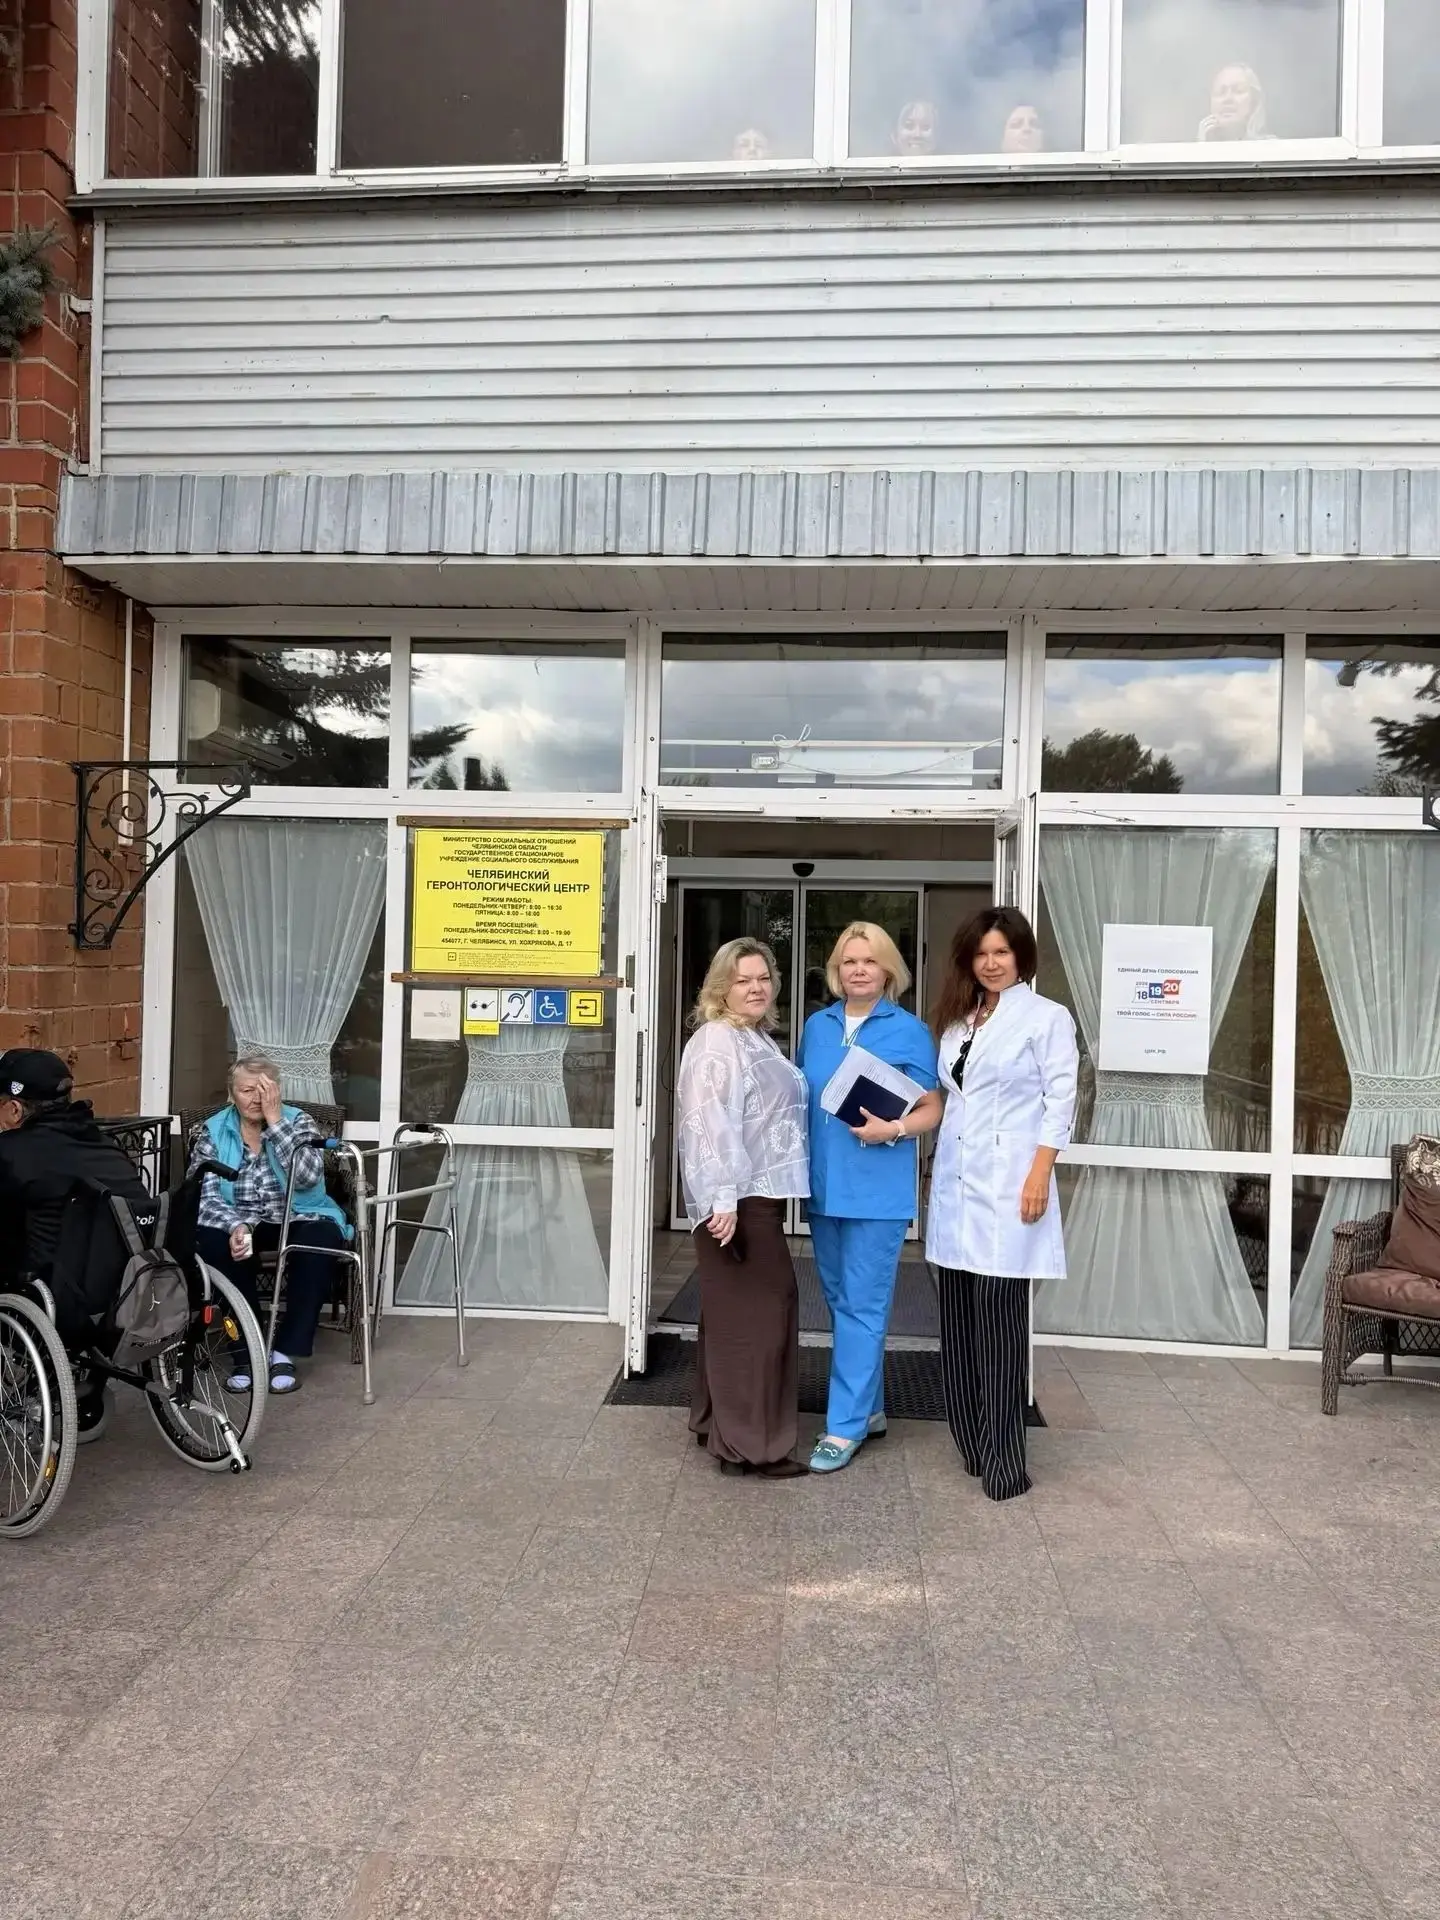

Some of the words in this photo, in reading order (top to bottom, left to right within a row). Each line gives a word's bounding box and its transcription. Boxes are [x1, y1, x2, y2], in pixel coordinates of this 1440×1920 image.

[467, 869, 550, 880] ЧЕЛЯБИНСКИЙ
[426, 880, 551, 892] ГЕРОНТОЛОГИЧЕСКИЙ
[553, 883, 590, 894] ЦЕНТР
[453, 902, 528, 910] ПОНЕДЕЛЬНИК-ЧЕТВЕРГ:
[1136, 991, 1148, 1000] 18
[1150, 986, 1162, 996] 19
[1164, 982, 1179, 992] 20
